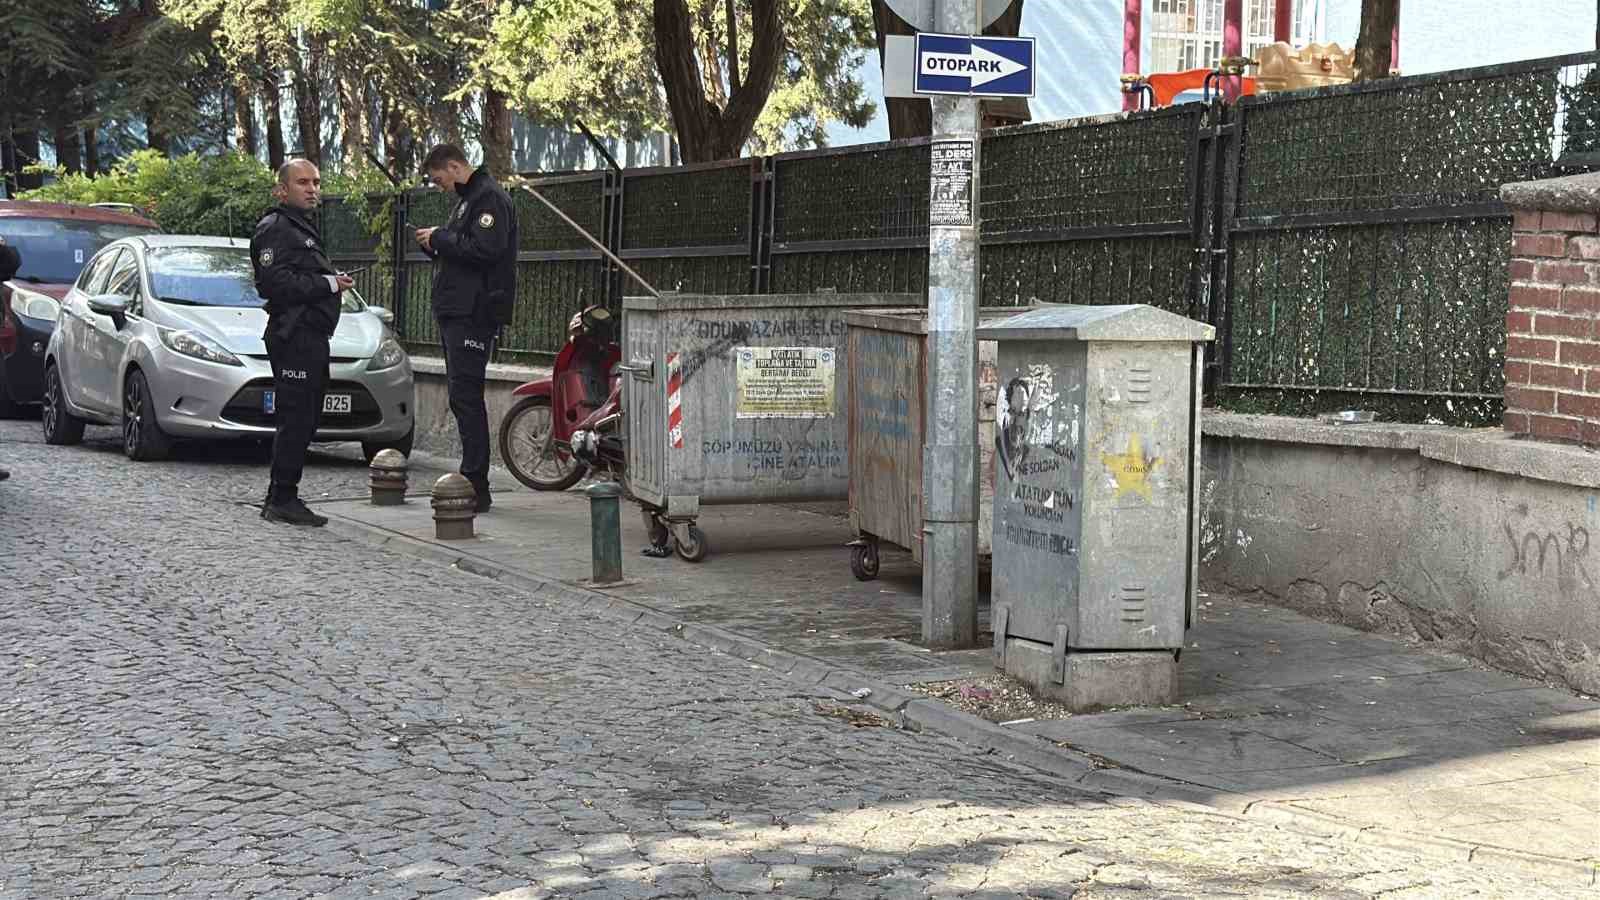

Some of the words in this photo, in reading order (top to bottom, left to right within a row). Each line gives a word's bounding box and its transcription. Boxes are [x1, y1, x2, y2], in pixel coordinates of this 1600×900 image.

[927, 57, 1002, 73] OTOPARK
[946, 149, 972, 158] DERS
[757, 359, 785, 368] TOPLAMA
[785, 359, 793, 368] VE
[788, 455, 842, 469] ATALIM
